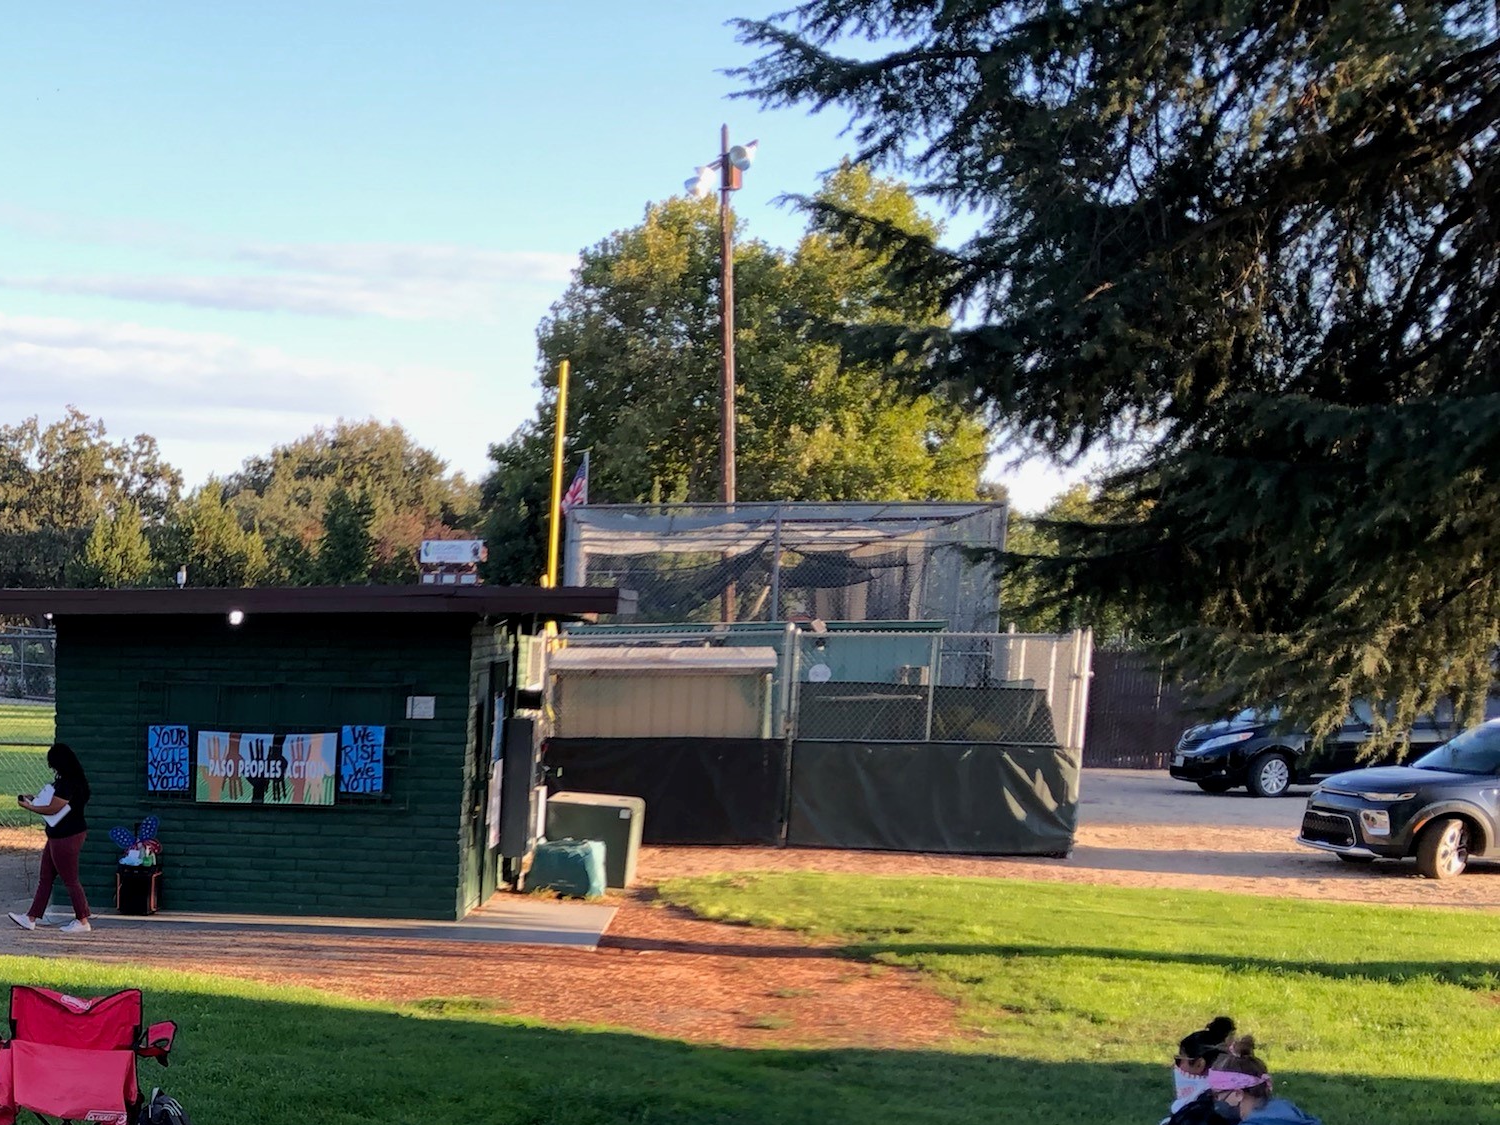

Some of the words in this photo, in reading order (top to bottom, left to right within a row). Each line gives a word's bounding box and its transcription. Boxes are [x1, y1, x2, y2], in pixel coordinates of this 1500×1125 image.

[150, 727, 188, 748] YOUR
[149, 746, 189, 763] VOTE
[342, 744, 382, 767] RISE
[149, 761, 186, 778] YOUR
[208, 759, 235, 777] PASO
[238, 760, 281, 779] PEOPLES
[284, 760, 325, 779] ACTION
[148, 774, 189, 791] VOICE
[340, 774, 382, 793] VOTE
